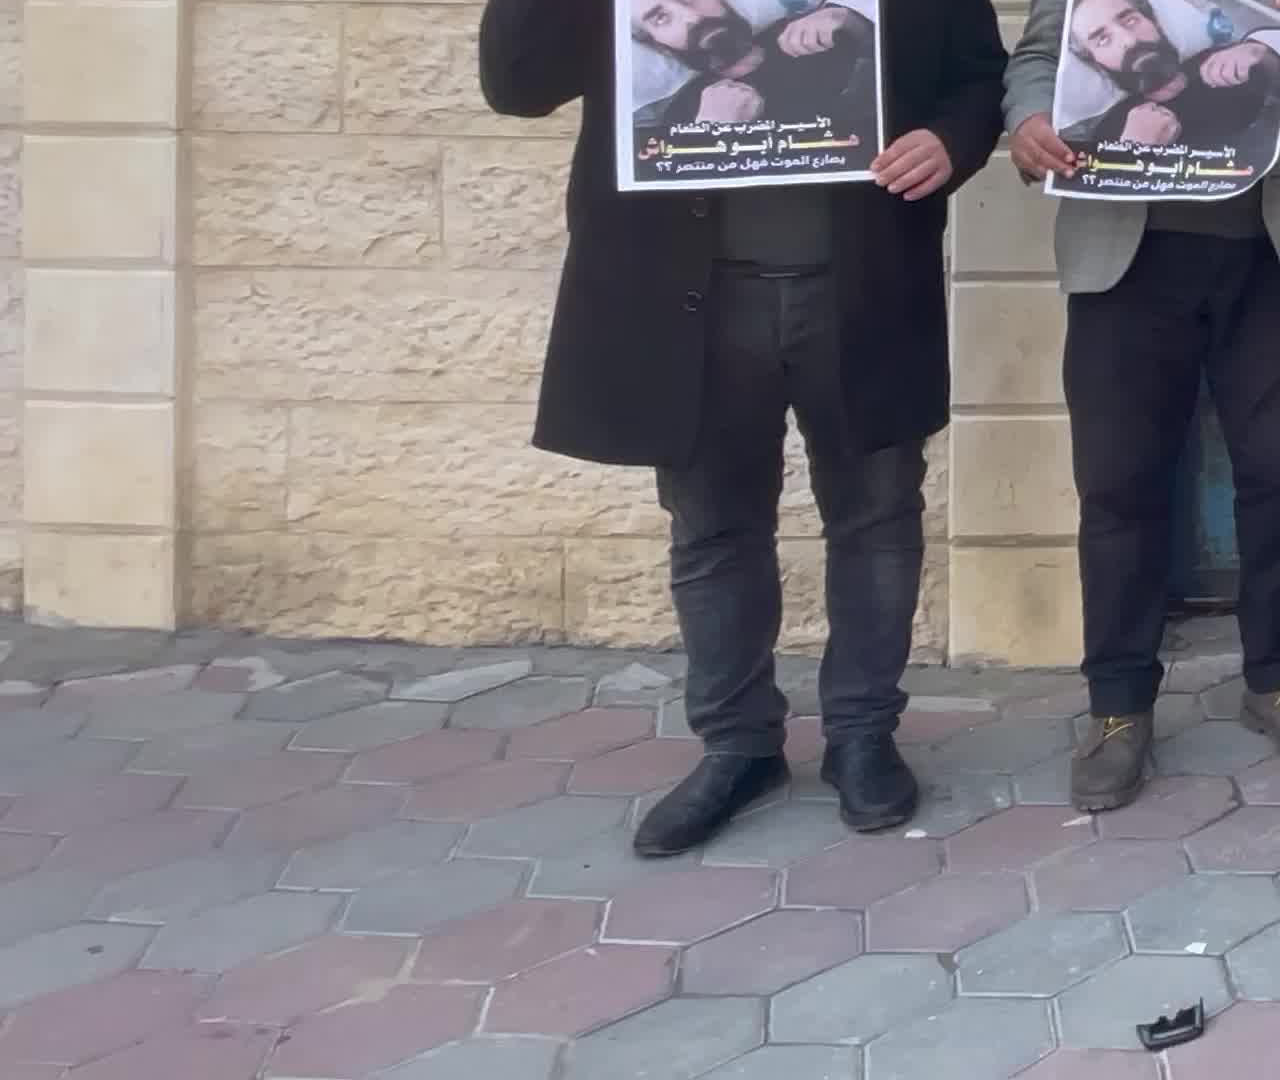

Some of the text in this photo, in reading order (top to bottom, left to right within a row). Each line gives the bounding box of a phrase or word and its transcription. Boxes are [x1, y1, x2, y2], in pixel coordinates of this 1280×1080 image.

[638, 131, 861, 160] هشام أبو هواش
